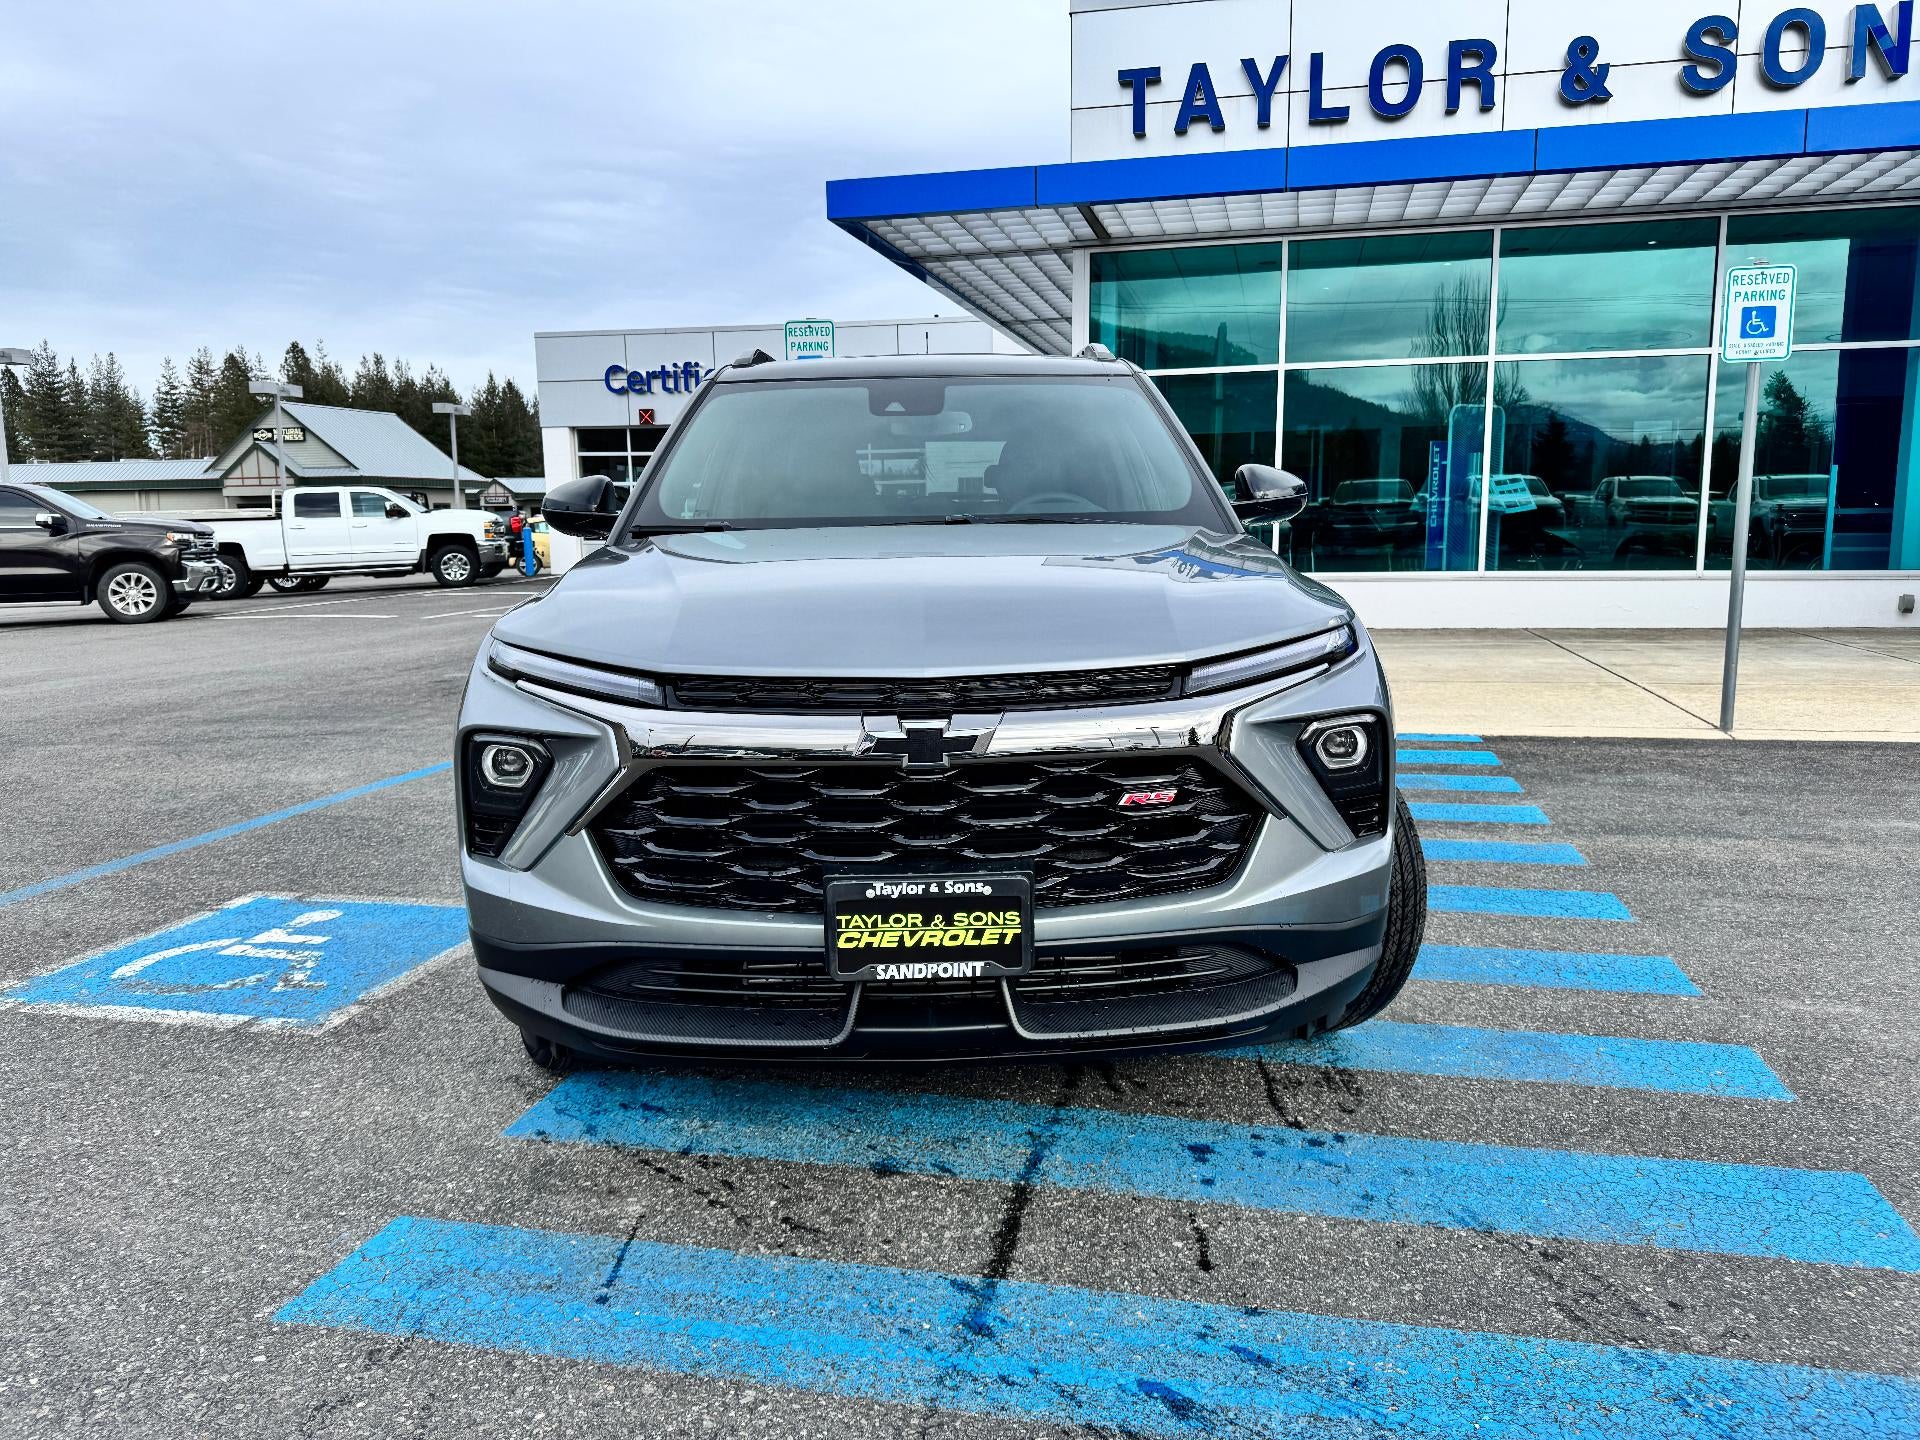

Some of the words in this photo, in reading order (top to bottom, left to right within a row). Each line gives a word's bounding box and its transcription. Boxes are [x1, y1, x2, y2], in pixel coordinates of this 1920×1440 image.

[1117, 38, 1498, 137] TAYLOR
[1560, 35, 1613, 106] &
[1681, 0, 1914, 95] SON
[1732, 272, 1790, 287] RESERVED
[1734, 289, 1786, 303] PARKING
[787, 326, 831, 338] RESERVED
[790, 340, 829, 352] PARKING
[1430, 445, 1440, 527] CHEVROLET
[1117, 789, 1178, 806] RS
[872, 881, 925, 898] Taylor
[929, 882, 939, 893] &
[944, 880, 984, 894] Sons
[836, 913, 922, 929] TAYLOR
[930, 913, 945, 929] &
[953, 911, 1021, 927] SONS
[837, 928, 1022, 949] CHEVROLET
[876, 961, 985, 980] SANDPOINT
